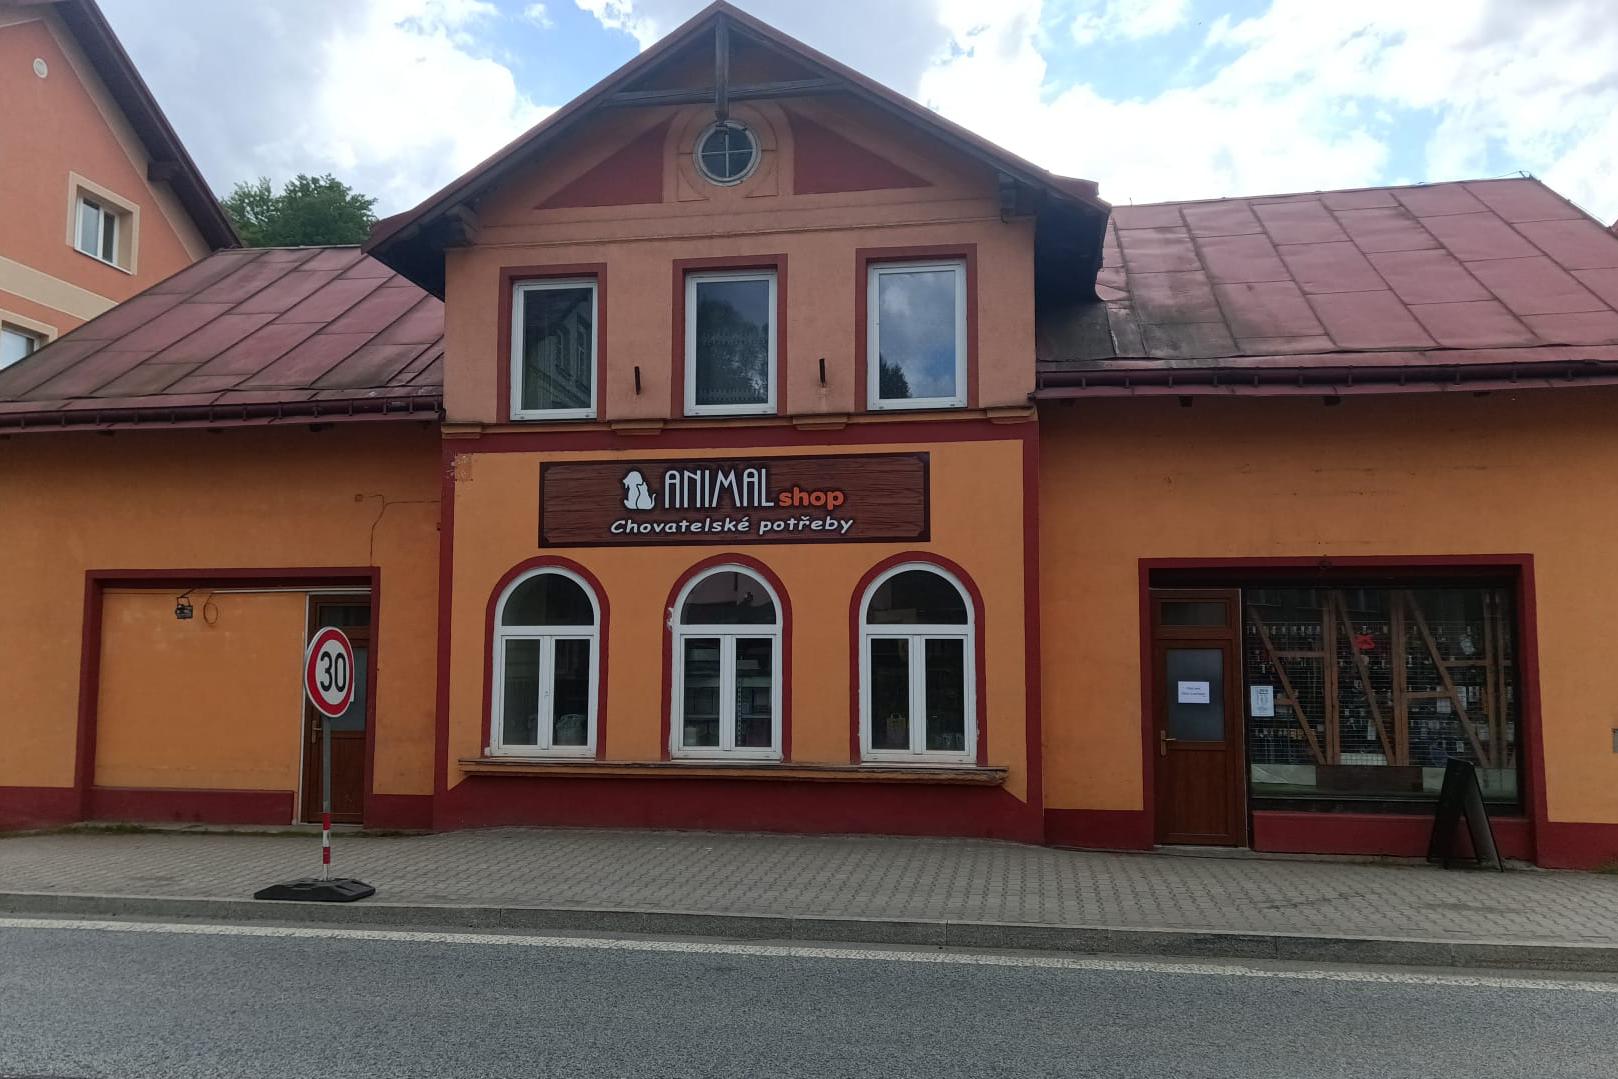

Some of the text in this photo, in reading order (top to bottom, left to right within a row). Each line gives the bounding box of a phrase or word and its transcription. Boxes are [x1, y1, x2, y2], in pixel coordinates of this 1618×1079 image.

[664, 468, 844, 509] ANIMAL shop
[611, 516, 853, 534] Chovatelské potřeby
[320, 651, 347, 692] 30
